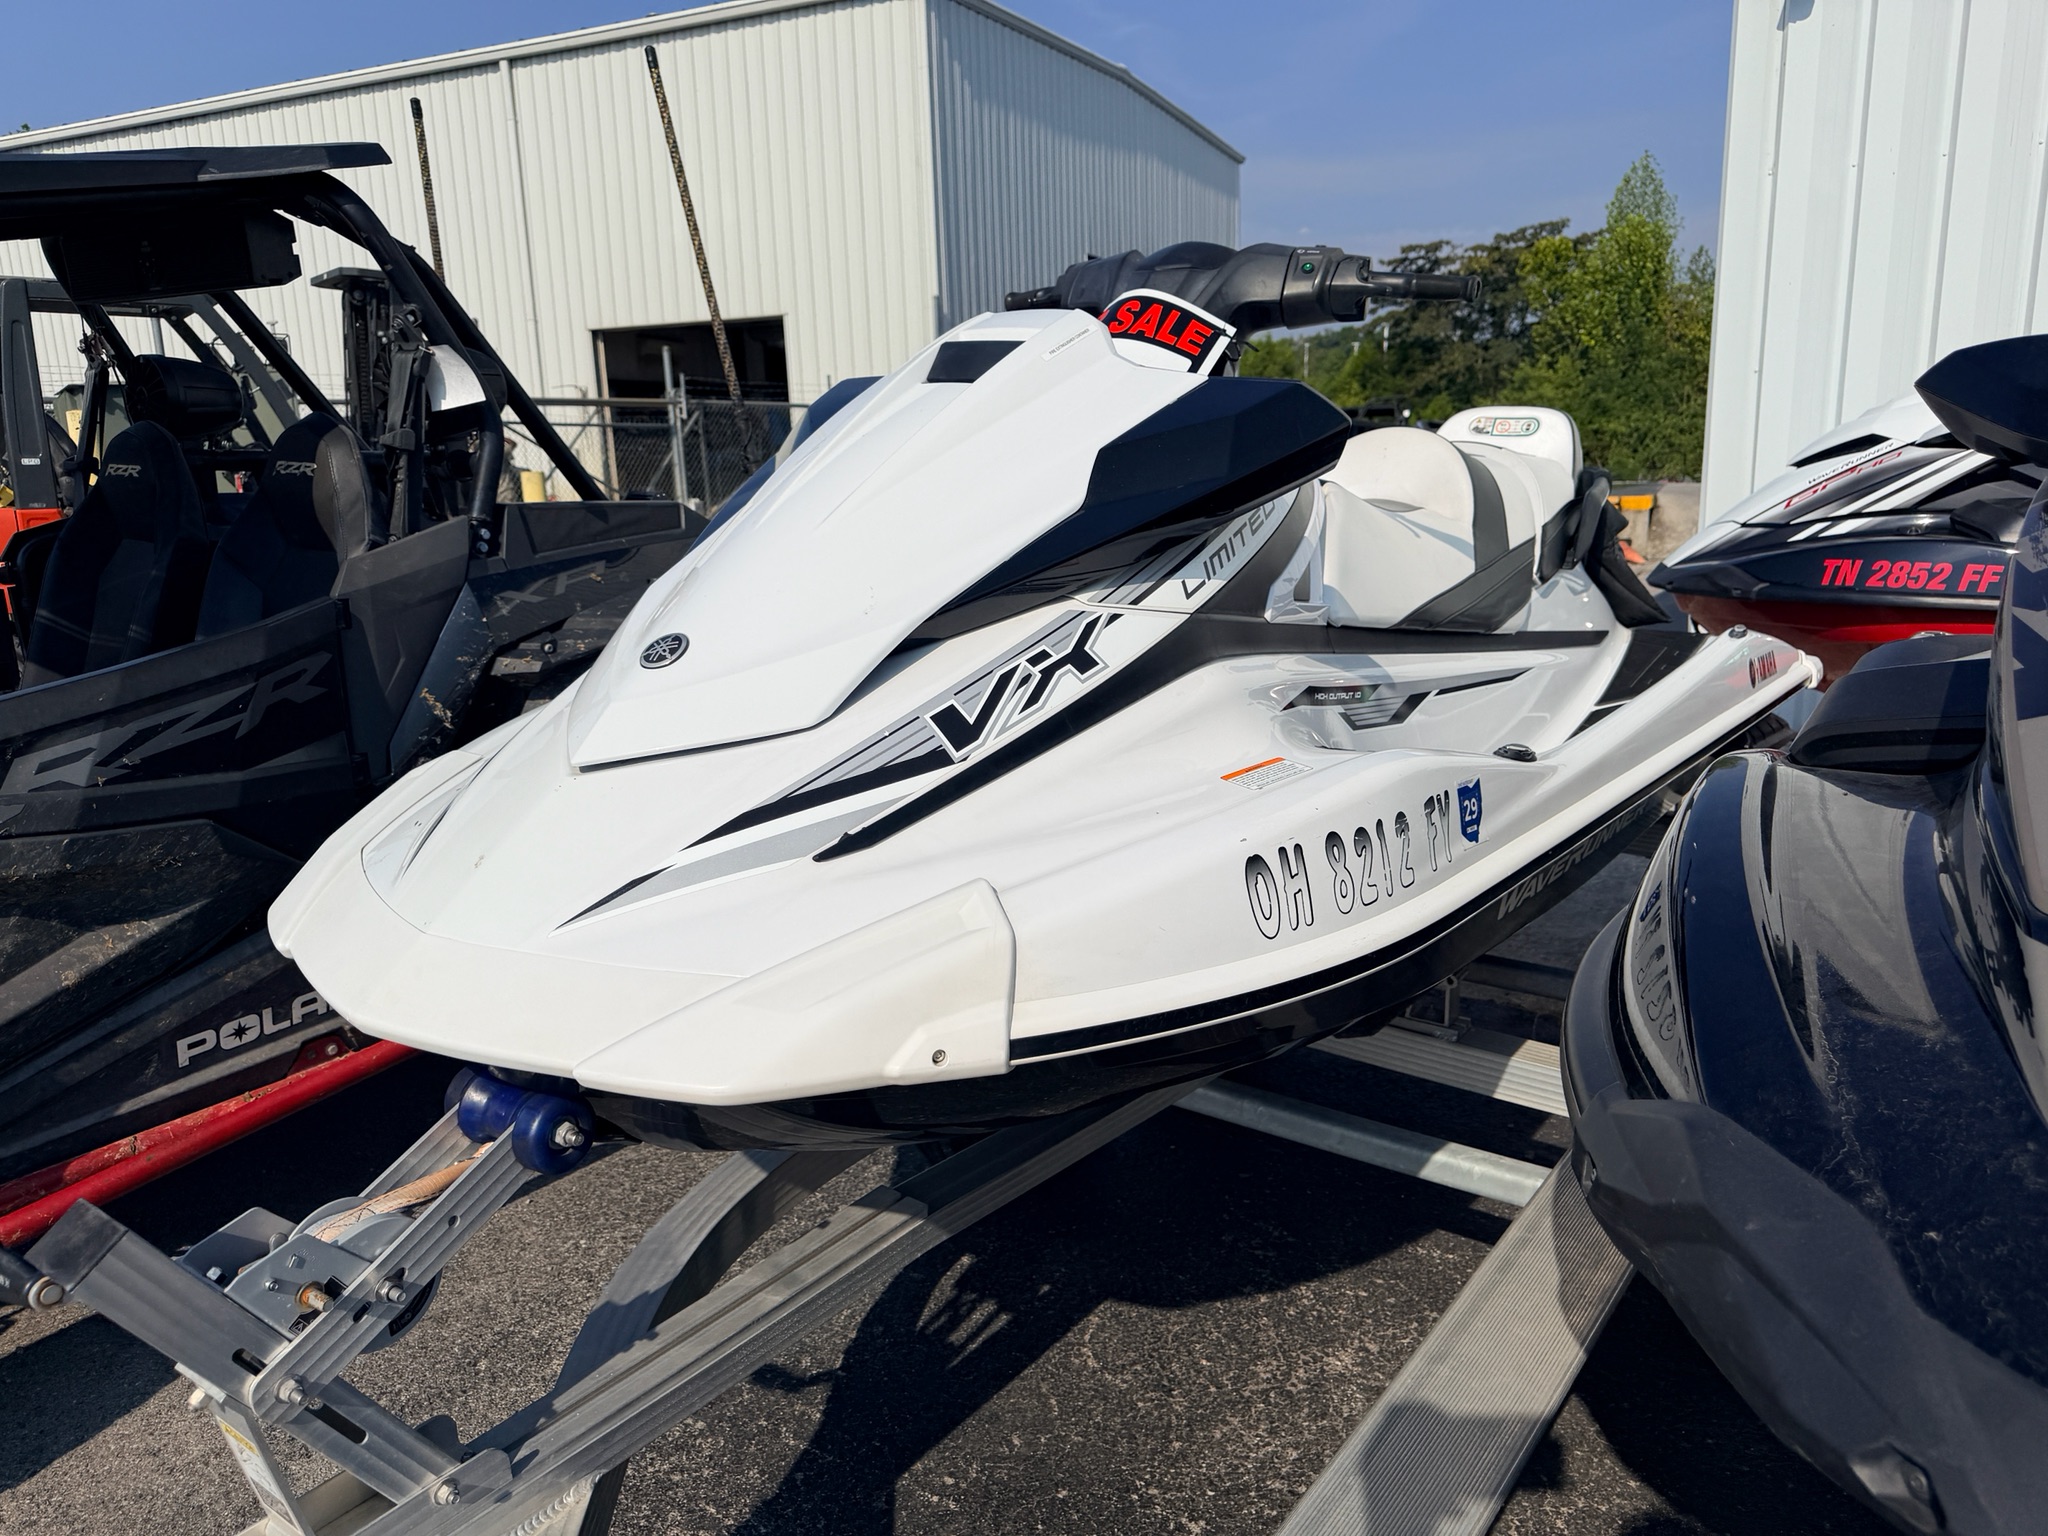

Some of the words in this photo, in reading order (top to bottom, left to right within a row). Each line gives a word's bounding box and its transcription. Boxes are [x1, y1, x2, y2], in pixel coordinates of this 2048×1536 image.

[1108, 299, 1214, 357] SALE
[105, 463, 142, 478] RZR
[272, 460, 318, 477] RZR
[1181, 500, 1276, 601] LIMITED
[1821, 558, 1865, 587] TN
[1865, 560, 1953, 591] 2852
[1957, 563, 2006, 593] FF
[926, 610, 1106, 759] VX
[1328, 692, 1354, 701] OUTPUT
[0, 650, 333, 794] RZR
[1463, 797, 1479, 822] 29
[1245, 843, 1314, 940] OH
[1325, 811, 1415, 915] 8212
[1423, 789, 1453, 873] FY
[1497, 801, 1651, 921] WAVERUNNER
[176, 990, 333, 1069] POLA
